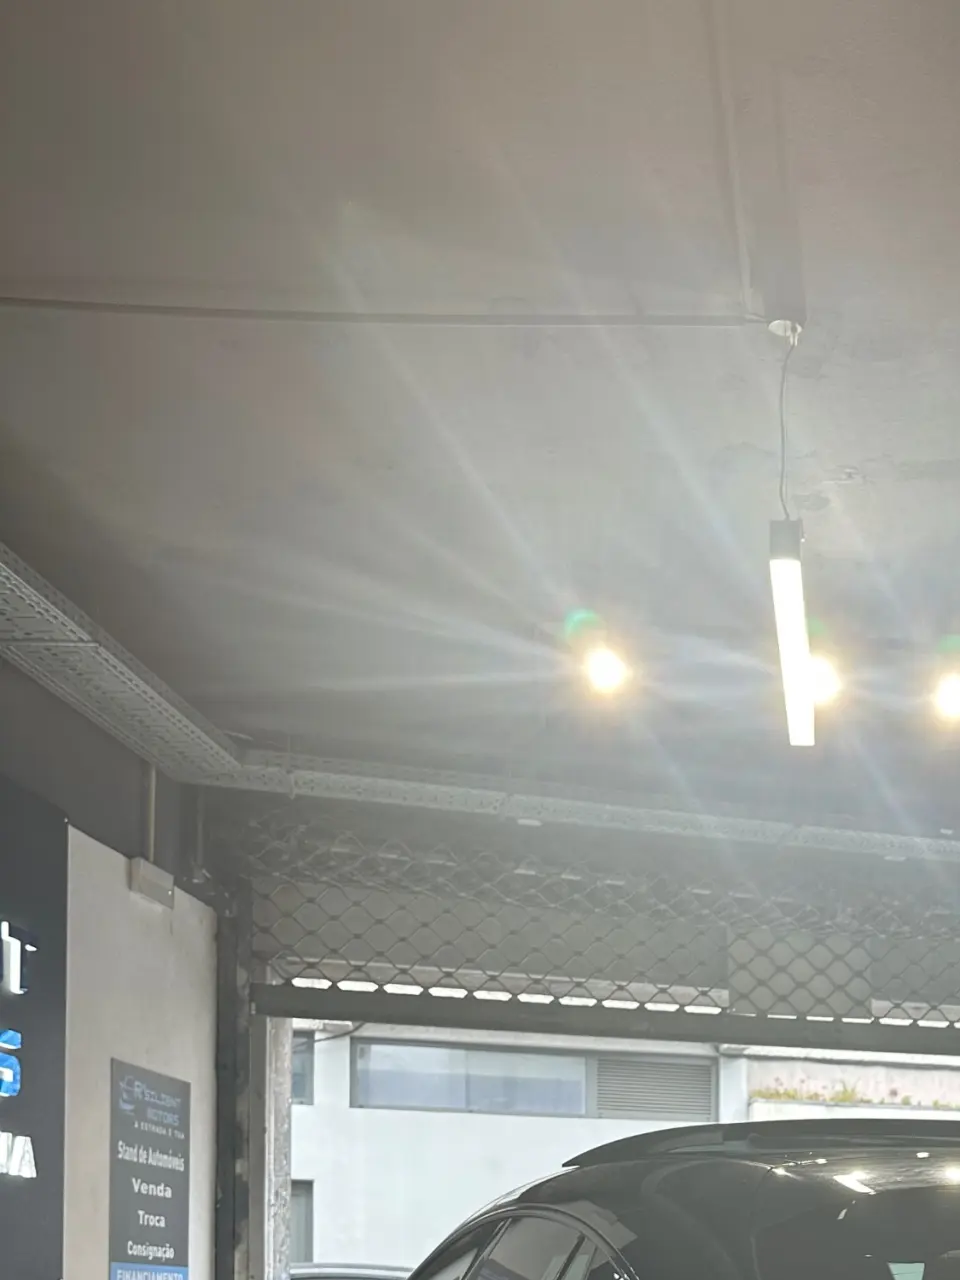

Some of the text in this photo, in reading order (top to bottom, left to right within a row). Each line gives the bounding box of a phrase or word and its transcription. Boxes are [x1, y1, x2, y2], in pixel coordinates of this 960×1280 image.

[118, 1140, 185, 1172] Stand de Automóveis
[132, 1177, 172, 1199] Venda
[137, 1209, 166, 1228] Troca
[127, 1240, 175, 1263] Consignação
